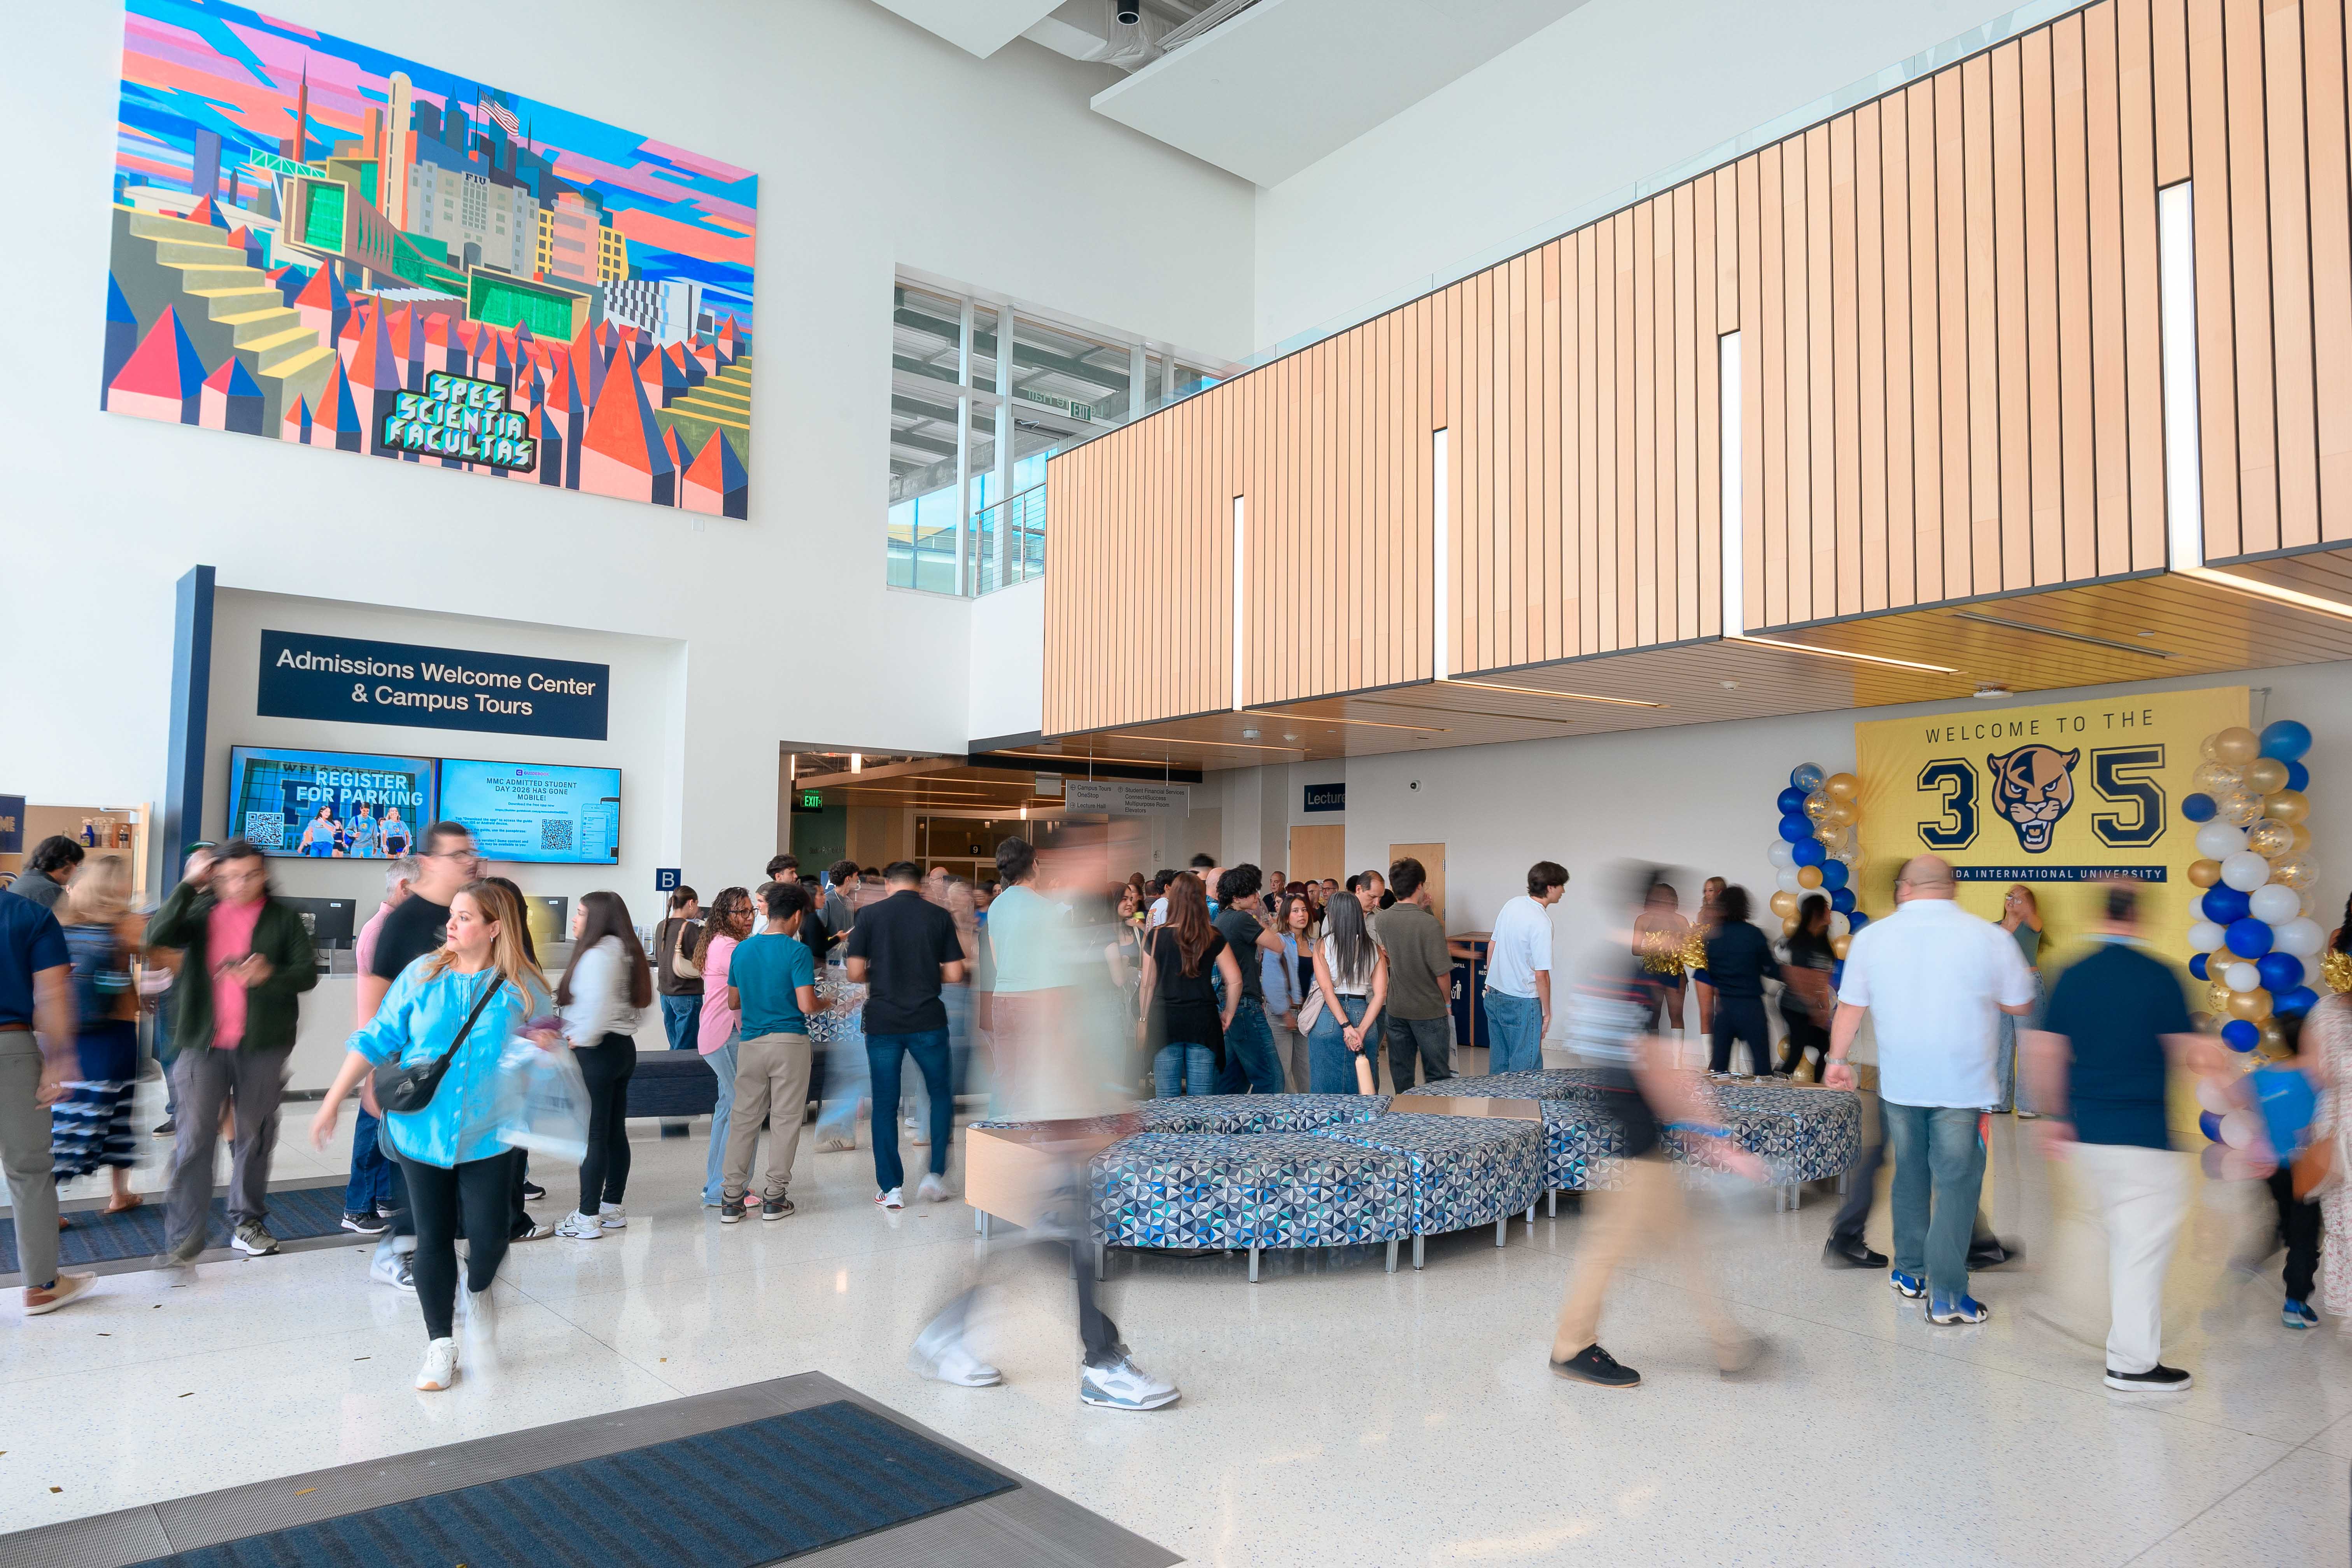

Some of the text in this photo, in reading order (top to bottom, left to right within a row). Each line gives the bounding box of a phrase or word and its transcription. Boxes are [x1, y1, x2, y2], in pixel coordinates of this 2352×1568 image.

[466, 173, 486, 185] FIU
[431, 376, 504, 411] SPES
[398, 394, 524, 440] SCIENTIA
[1074, 403, 1089, 420] EXIT
[387, 418, 531, 466] FACULTAS
[276, 649, 596, 695] Admissions Welcome Center
[352, 683, 533, 716] & Campus Tours
[1926, 709, 2153, 743] WELCOME TO THE
[315, 770, 407, 789] REGISTER
[296, 786, 423, 806] FOR PARKING
[804, 796, 819, 807] EXIT
[1308, 792, 1345, 805] Lecture
[662, 872, 675, 887] B
[1975, 870, 2074, 878] INTERNATIONAL
[2080, 870, 2162, 878] UNIVERSITY
